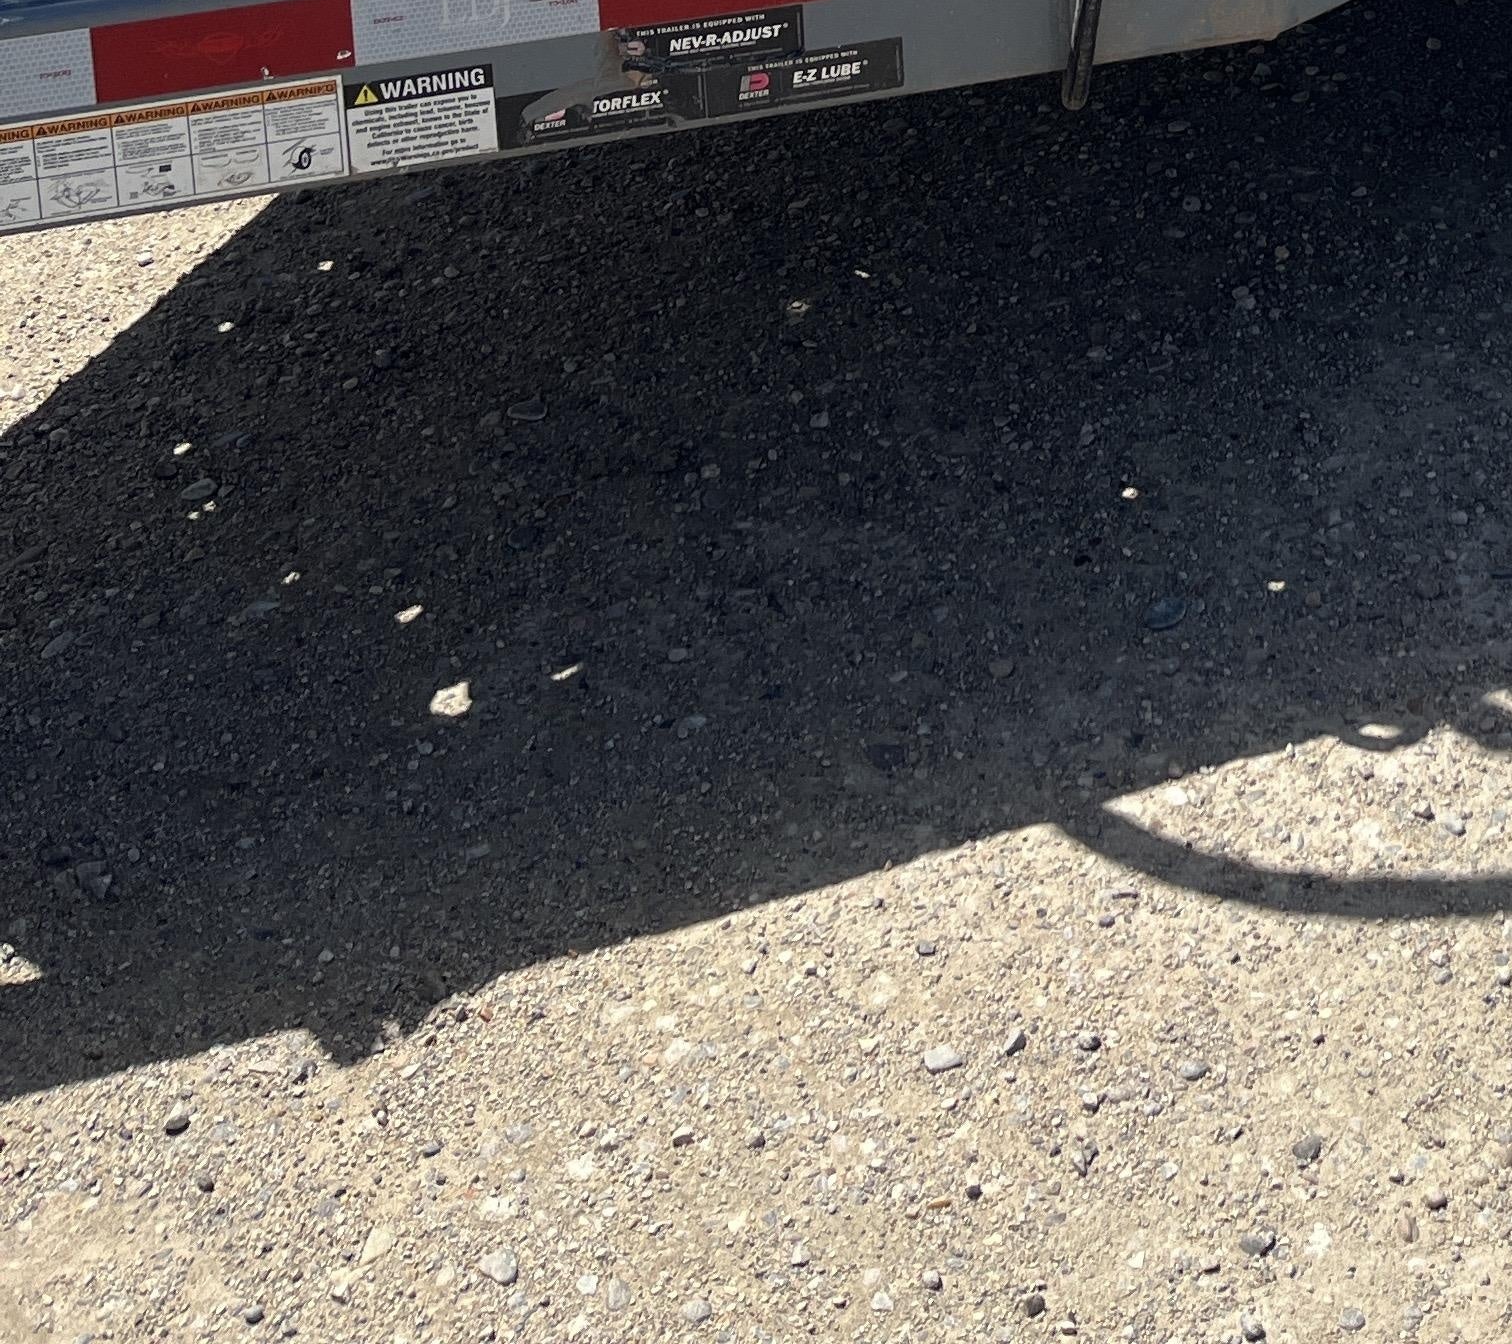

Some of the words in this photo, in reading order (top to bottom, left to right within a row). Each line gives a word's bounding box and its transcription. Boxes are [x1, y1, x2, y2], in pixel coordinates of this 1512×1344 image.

[657, 24, 690, 35] TRAILER
[703, 17, 743, 28] EQUIPPED
[745, 14, 765, 22] WITH
[669, 24, 782, 52] NEV-R-ADJUST
[765, 60, 793, 69] TRAILER
[805, 53, 839, 63] EQUIPPED
[793, 68, 817, 84] E-Z
[821, 61, 861, 81] LUBE
[380, 68, 485, 100] WARNING
[199, 94, 260, 111] WARNING
[738, 89, 769, 101] DEXTER
[125, 106, 185, 122] WARNING
[47, 117, 107, 133] WARNING
[534, 119, 566, 132] DEXTER
